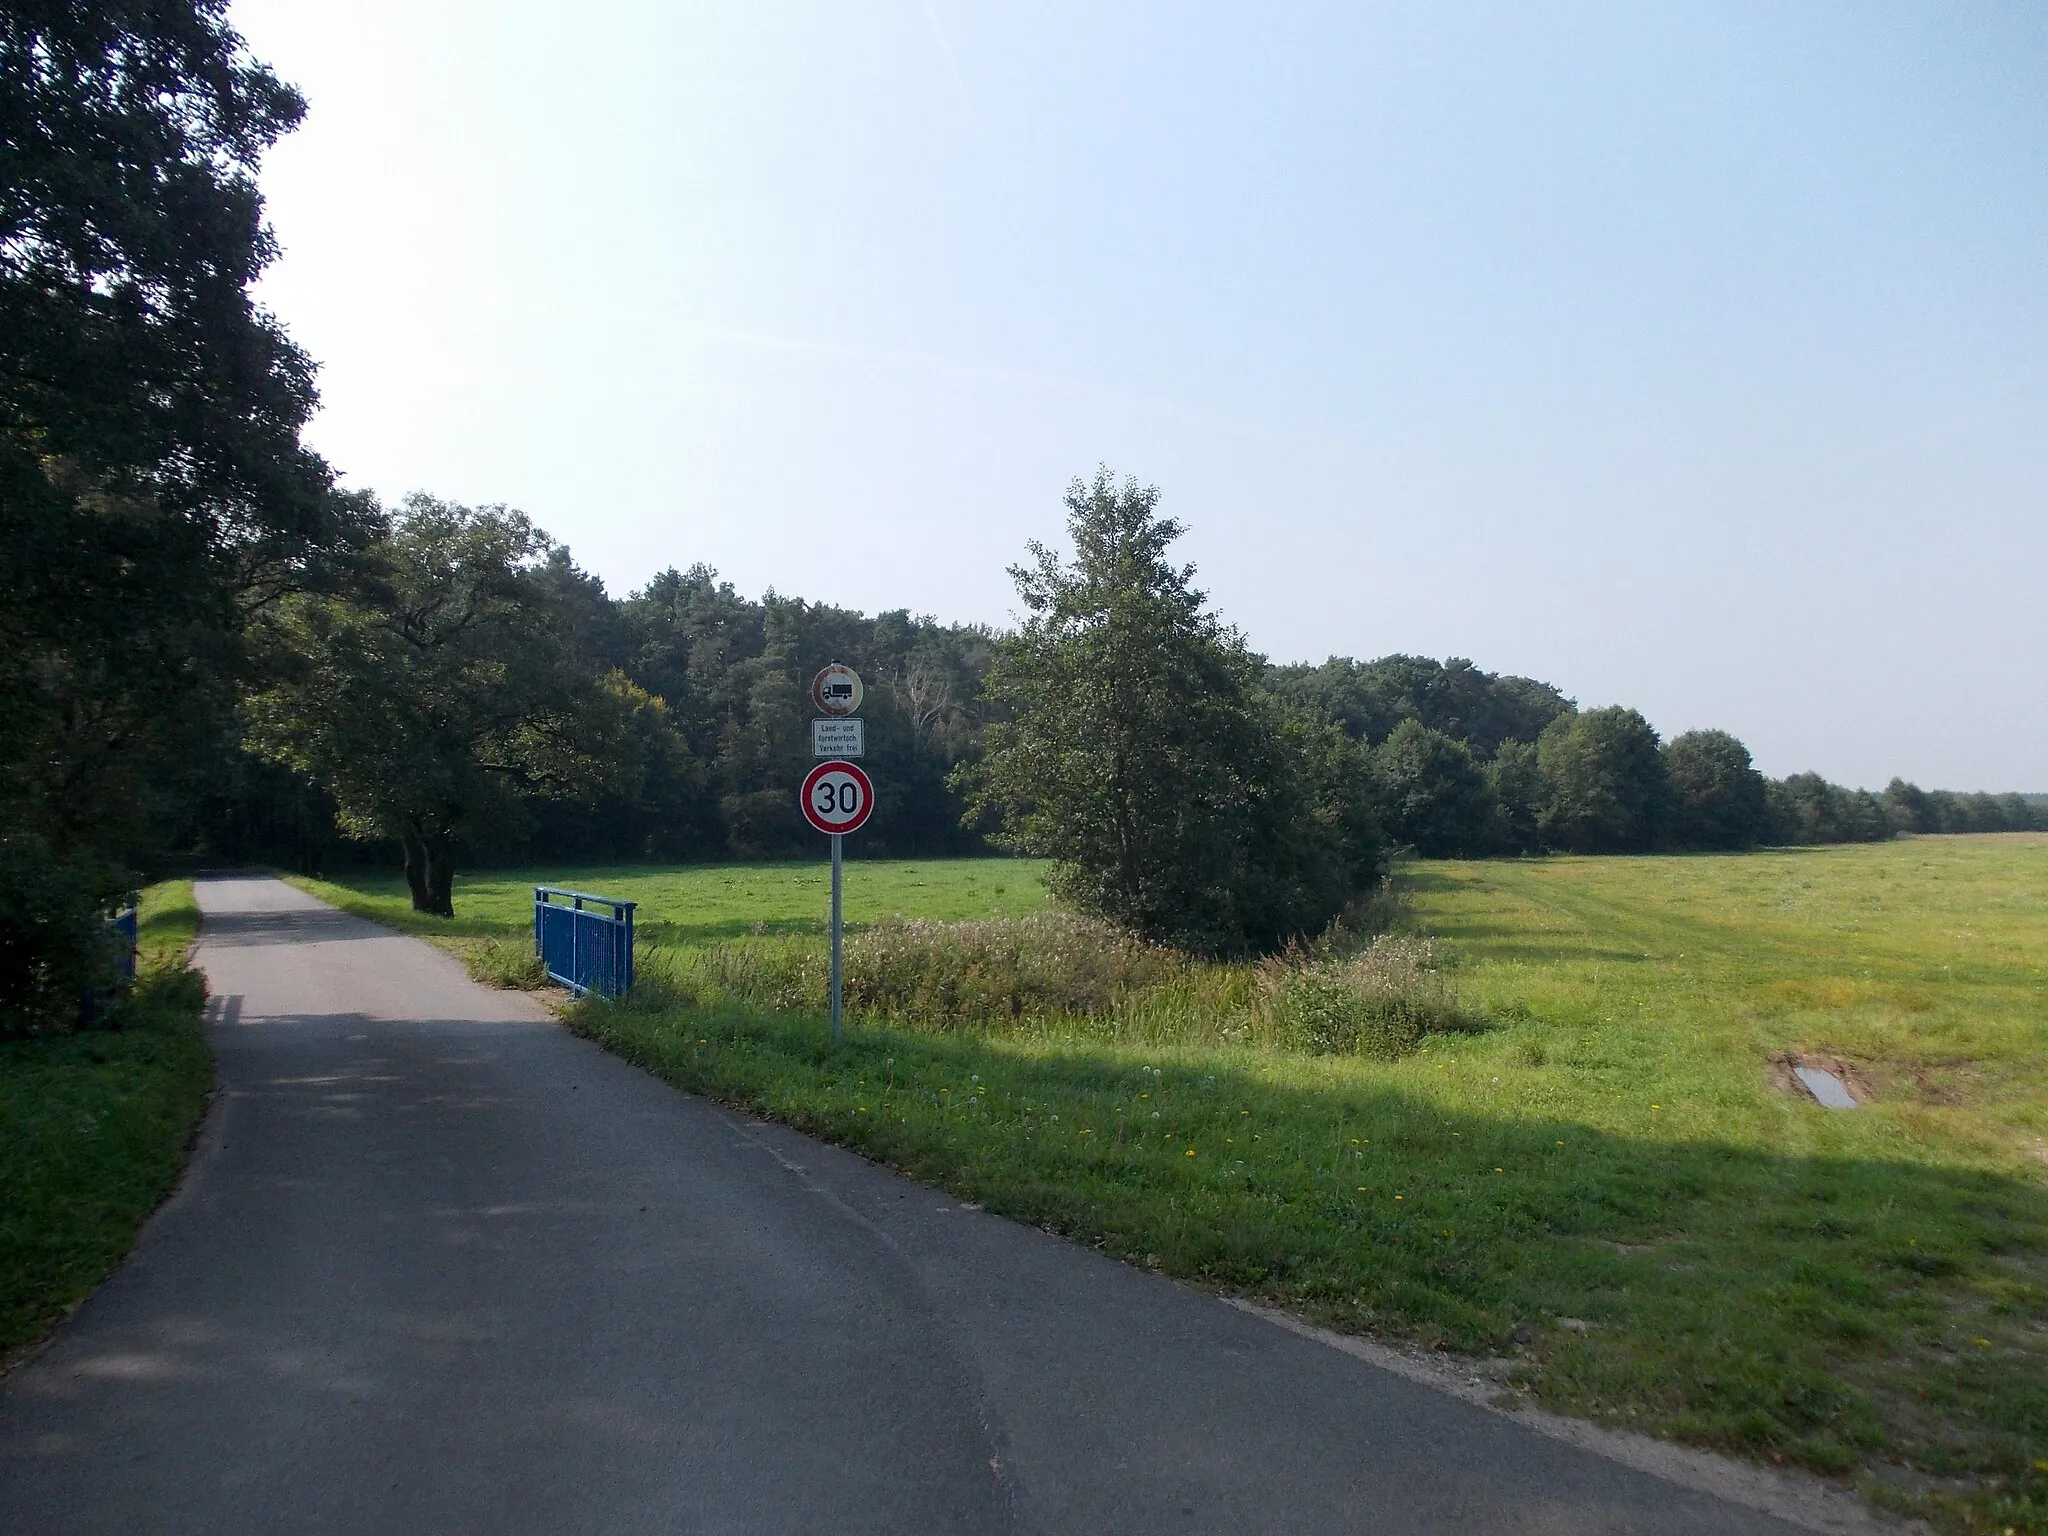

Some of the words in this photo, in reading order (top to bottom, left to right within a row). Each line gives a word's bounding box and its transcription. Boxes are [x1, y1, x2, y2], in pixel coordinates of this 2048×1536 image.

[843, 724, 855, 732] und
[819, 744, 843, 752] Verkehr
[846, 743, 858, 752] frei
[817, 782, 857, 814] 30
